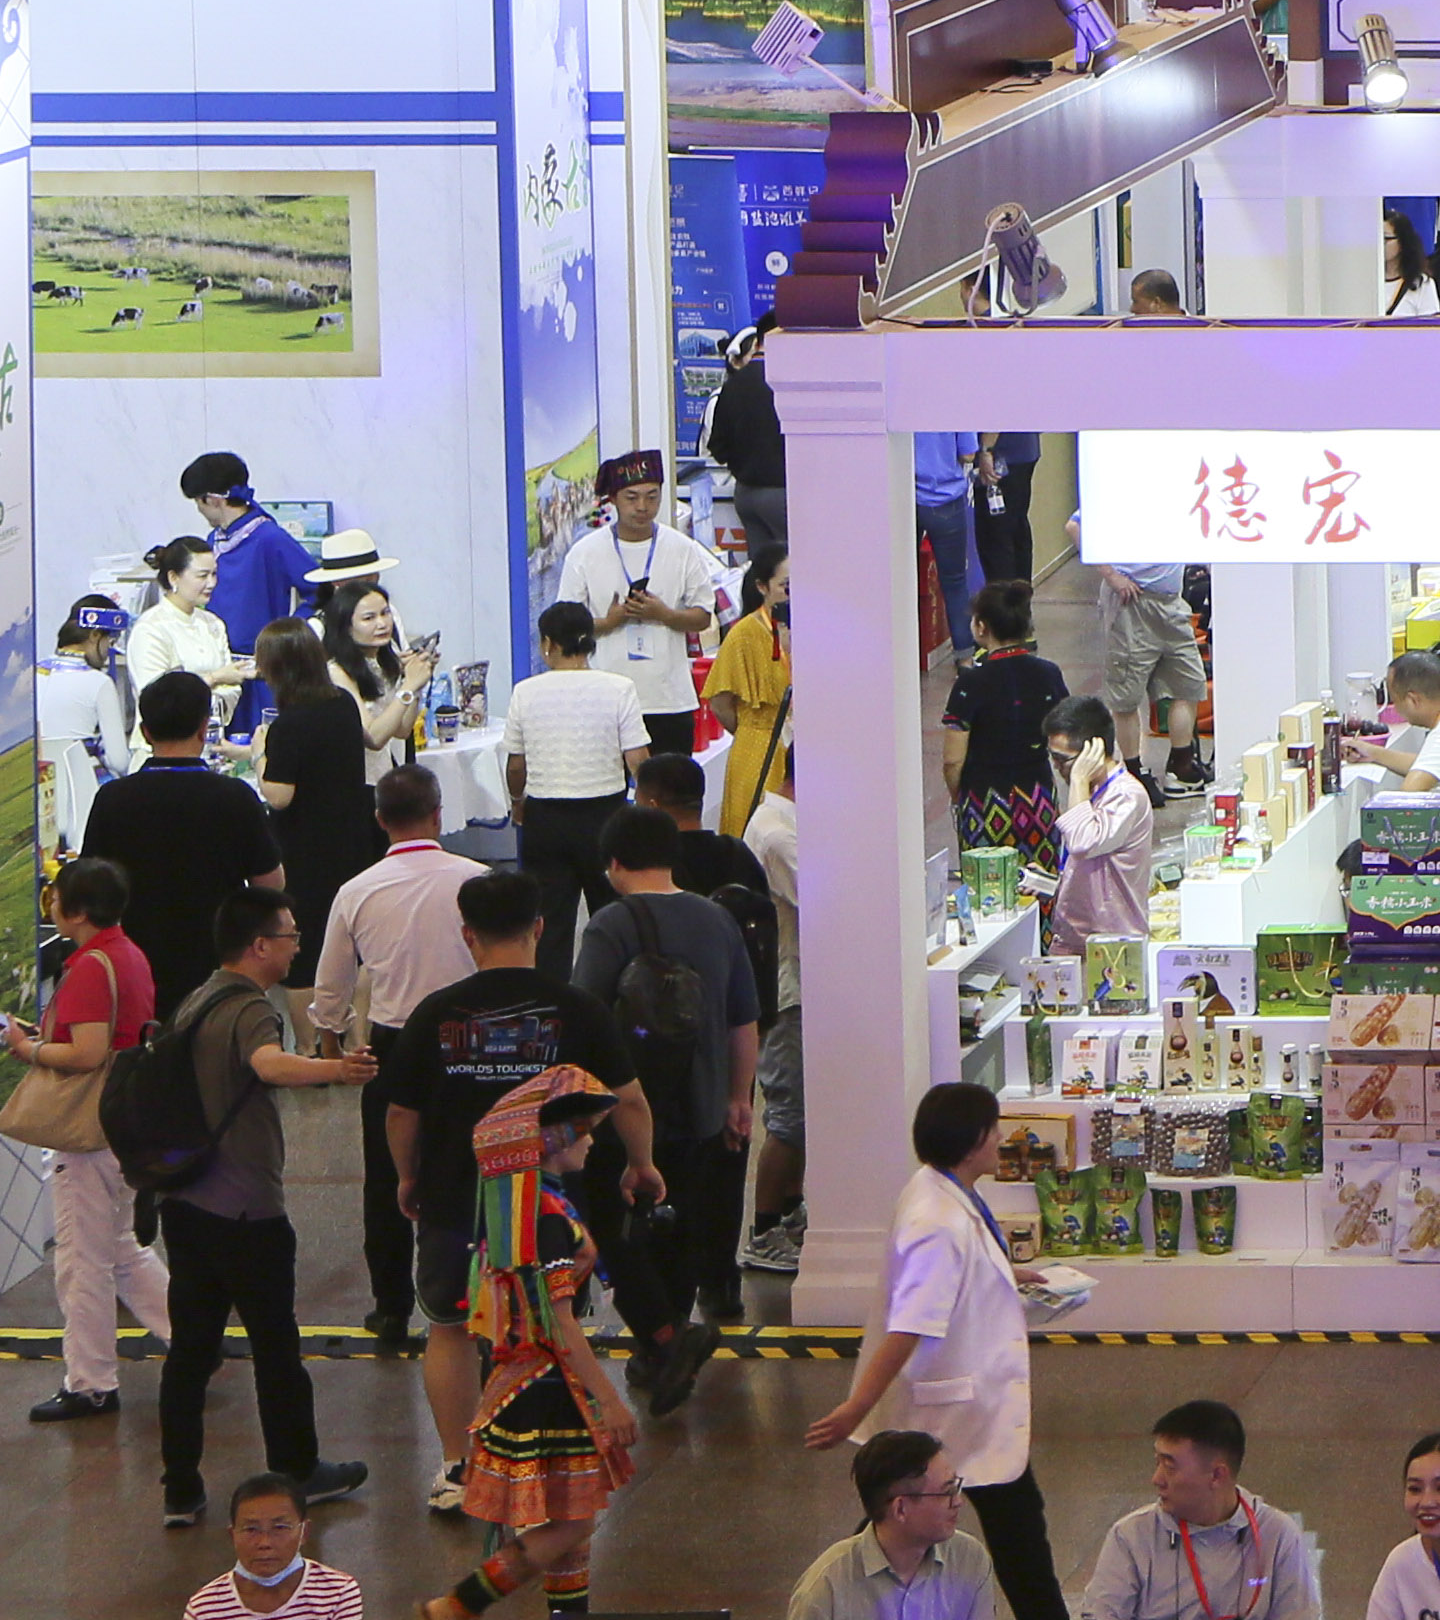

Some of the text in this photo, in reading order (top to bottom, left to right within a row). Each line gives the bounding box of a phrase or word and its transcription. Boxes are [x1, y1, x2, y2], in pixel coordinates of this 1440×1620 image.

[1189, 449, 1371, 546] 德宏
[1366, 893, 1435, 910] 香糯小玉米
